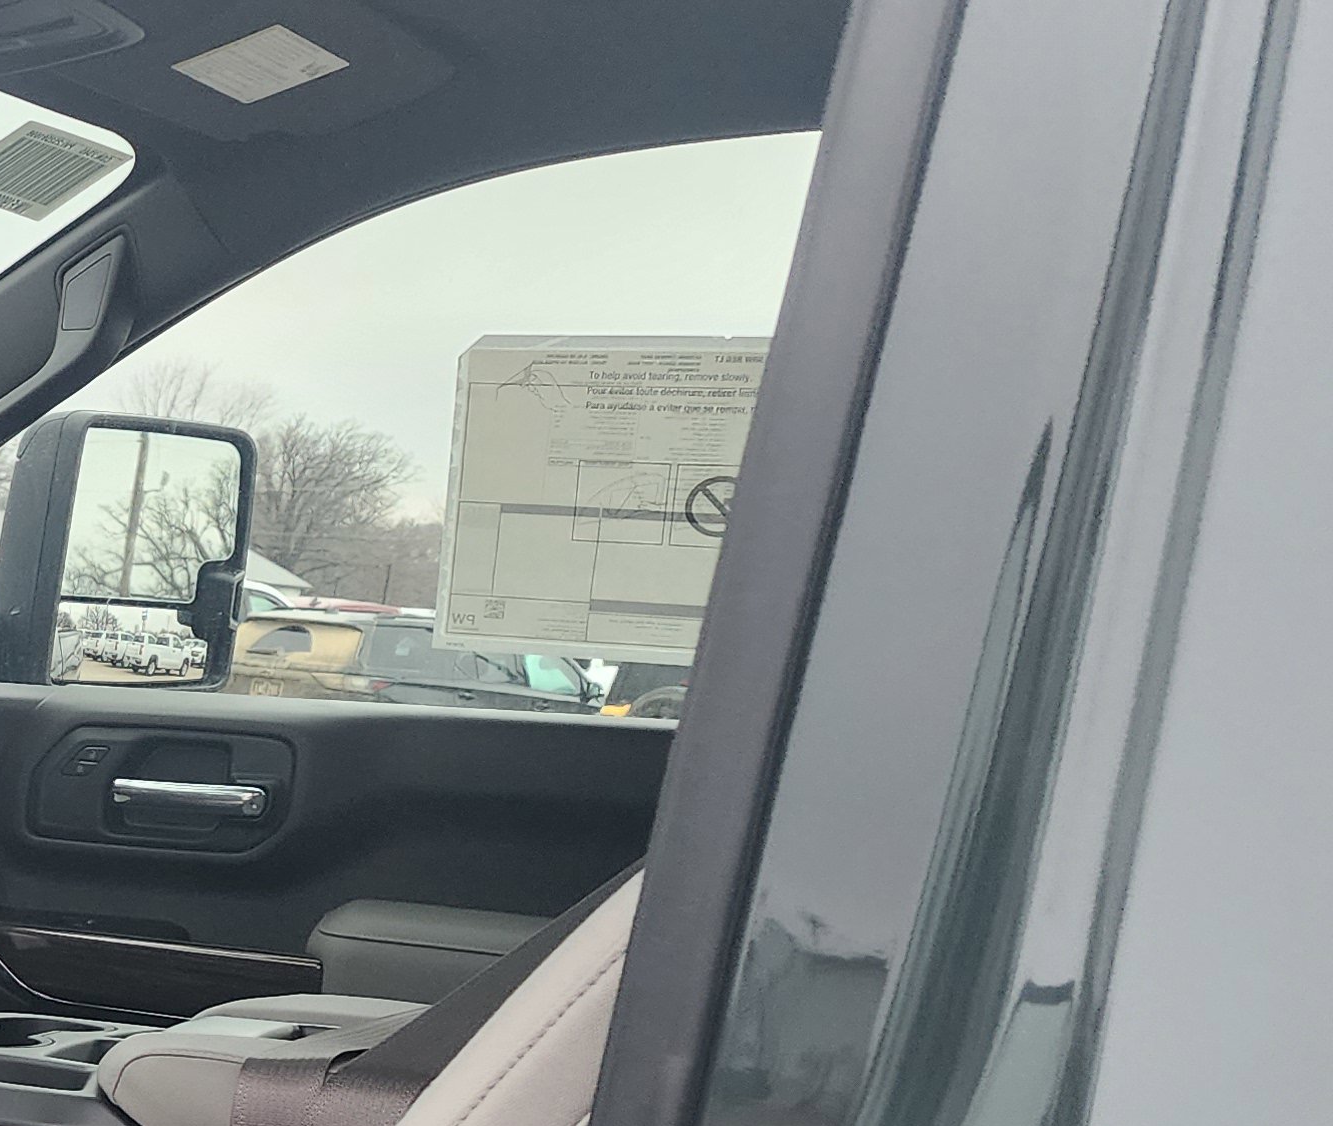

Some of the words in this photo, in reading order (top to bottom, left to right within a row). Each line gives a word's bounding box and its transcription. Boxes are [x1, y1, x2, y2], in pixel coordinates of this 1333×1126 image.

[589, 370, 599, 380] To
[601, 371, 620, 382] help
[623, 371, 646, 381] avoid
[684, 374, 719, 382] remove
[587, 387, 607, 396] Pour
[585, 401, 605, 410] Para
[684, 405, 702, 414] que
[703, 406, 714, 414] se
